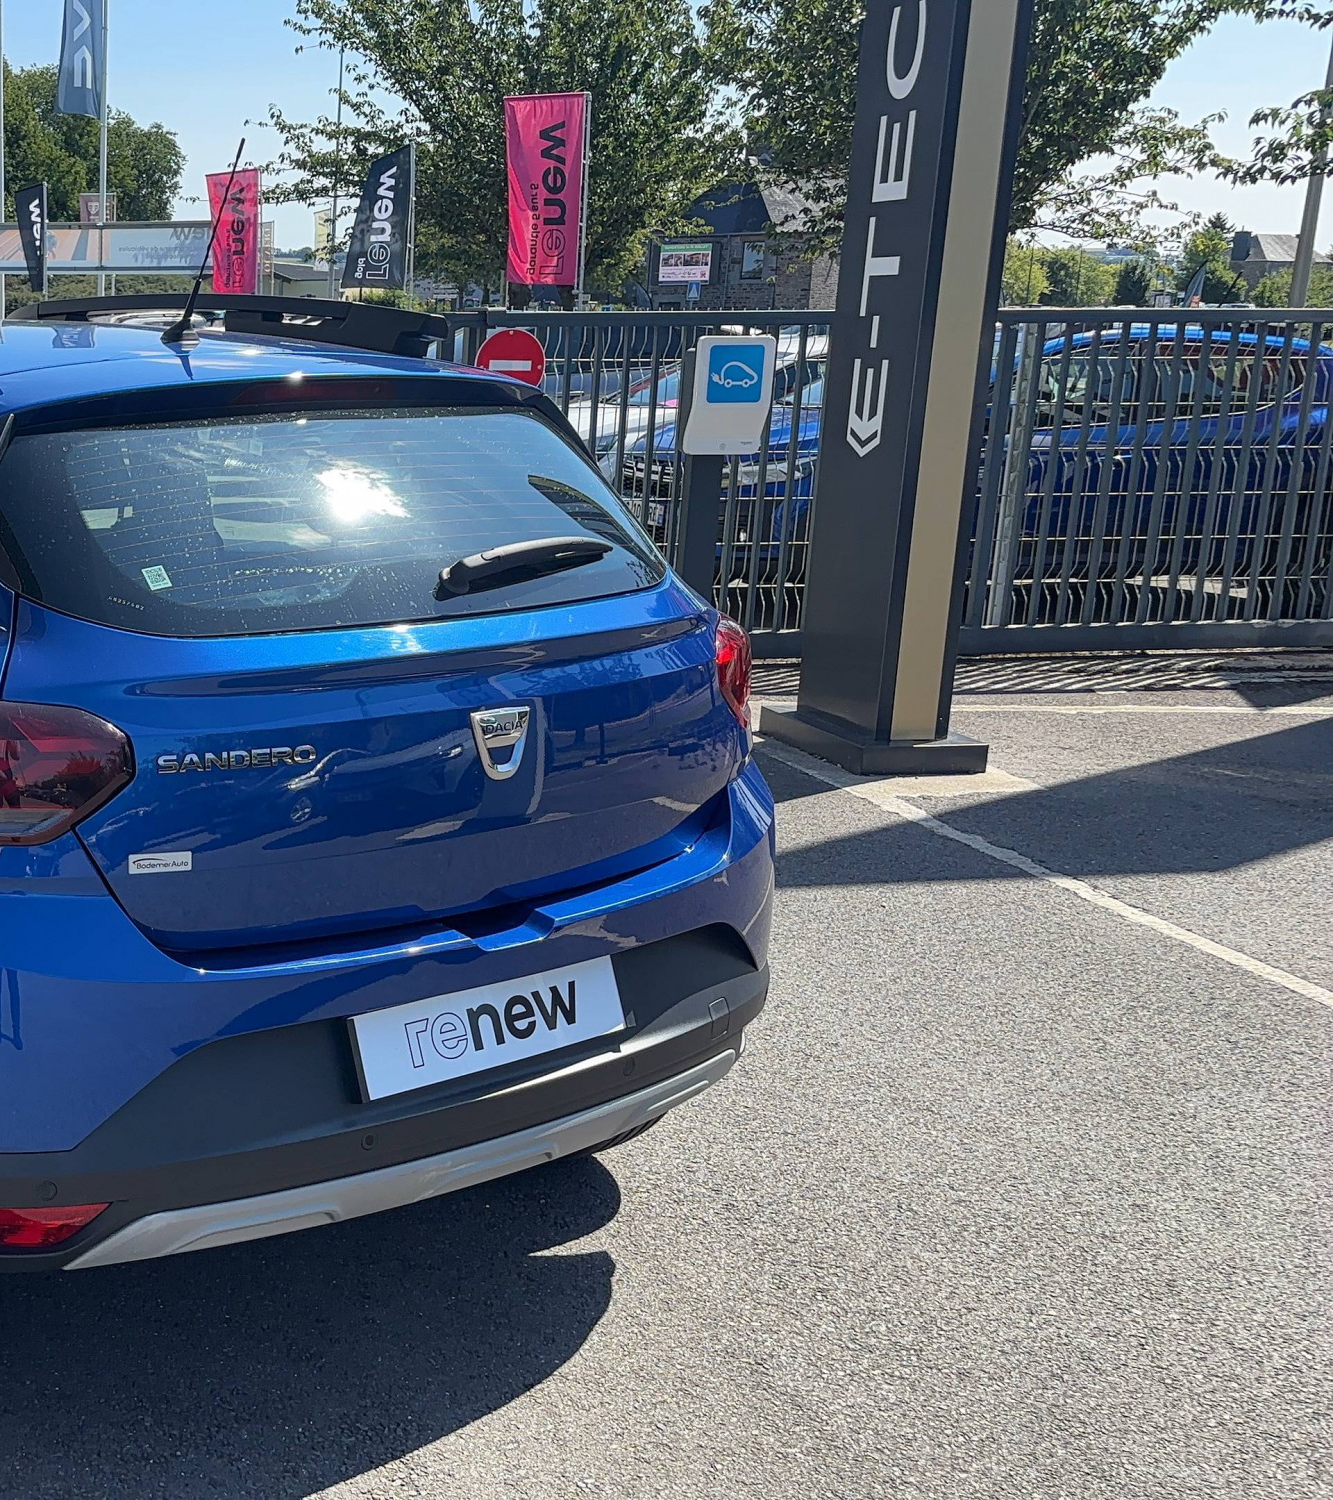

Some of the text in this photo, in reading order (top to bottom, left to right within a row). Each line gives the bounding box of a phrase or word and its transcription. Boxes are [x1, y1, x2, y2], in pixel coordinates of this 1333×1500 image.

[485, 719, 523, 734] DACIA
[157, 744, 317, 775] SANDERO
[404, 979, 577, 1069] renew
